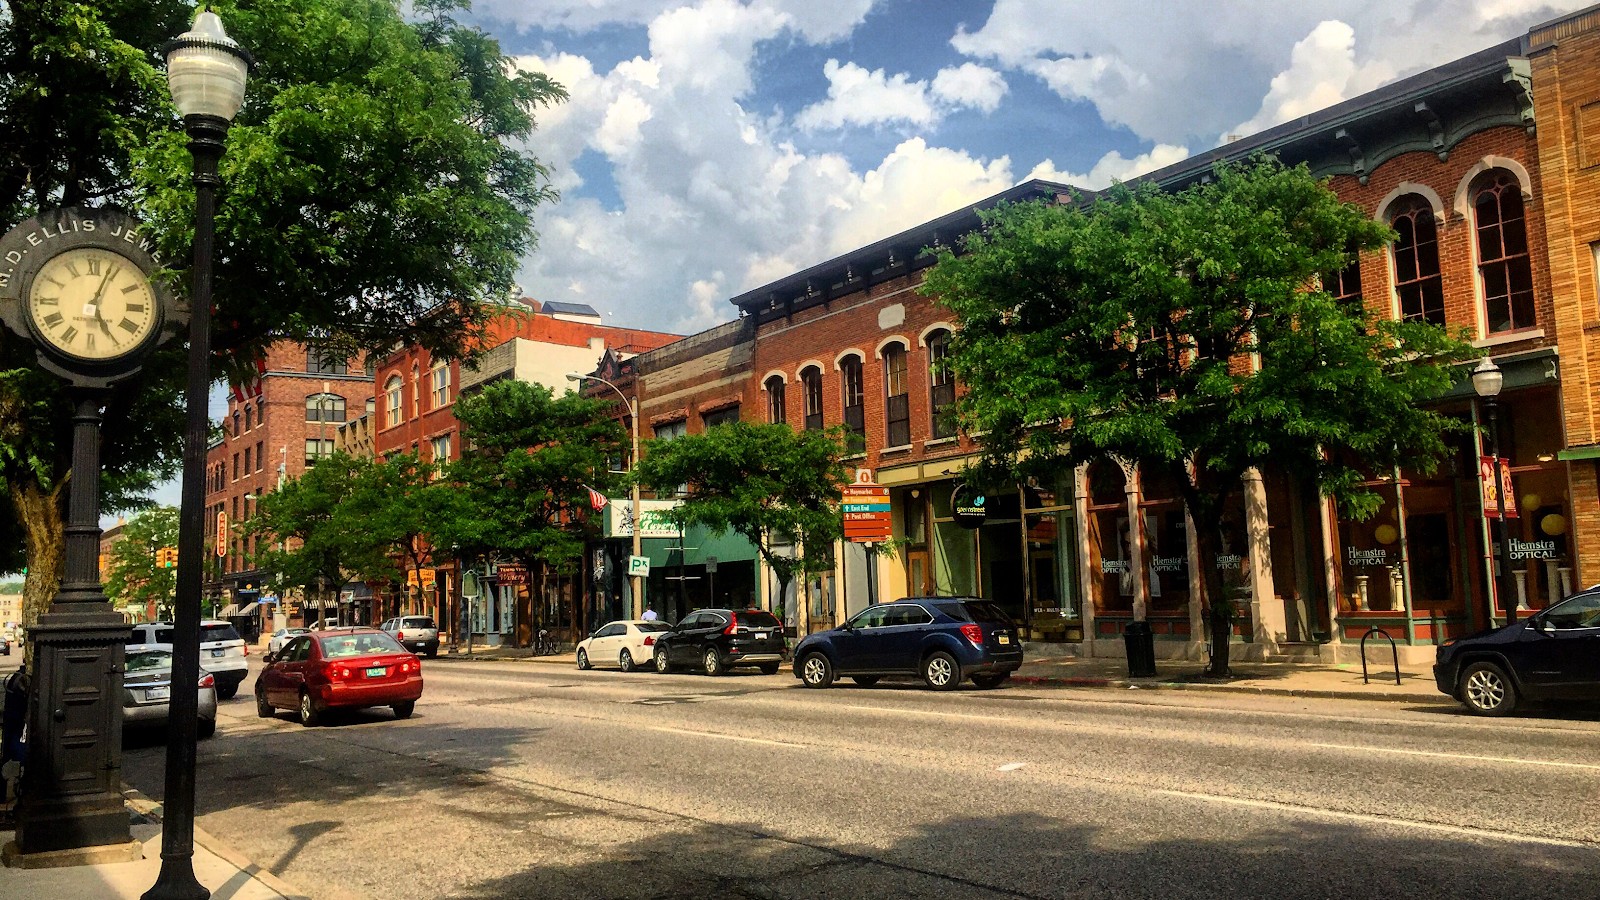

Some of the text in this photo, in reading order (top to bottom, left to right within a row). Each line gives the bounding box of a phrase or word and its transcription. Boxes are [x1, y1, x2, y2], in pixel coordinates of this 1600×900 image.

[26, 220, 96, 247] ELLIS
[1508, 538, 1555, 551] Hiemstra
[1215, 552, 1241, 562] iemstra
[1348, 546, 1386, 558] Hiemstra
[1509, 551, 1556, 560] OPTICAL
[1101, 557, 1127, 567] Hiemstra
[1153, 554, 1182, 566] Hiemstra
[1349, 557, 1386, 566] OPTICAL
[1153, 565, 1181, 573] OPTICAL
[1216, 562, 1241, 570] PTICAL
[499, 573, 526, 583] Winery
